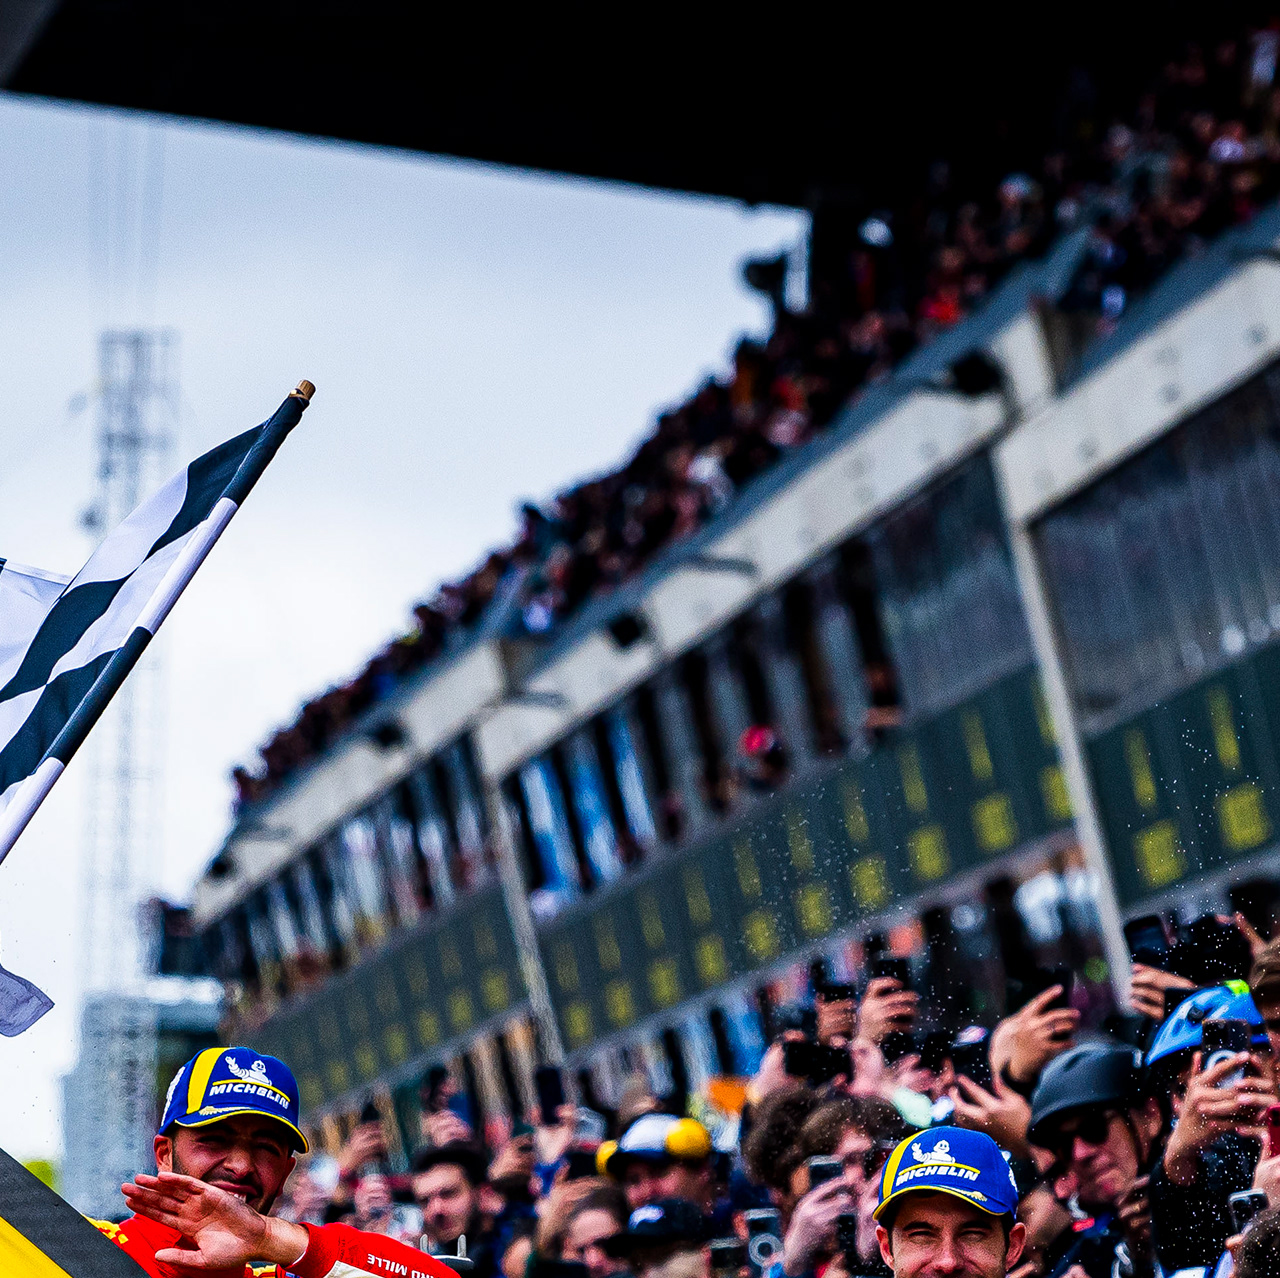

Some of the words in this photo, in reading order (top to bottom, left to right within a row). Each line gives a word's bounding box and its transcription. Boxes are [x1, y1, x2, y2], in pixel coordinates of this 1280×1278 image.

[209, 1083, 290, 1110] MICHELIN
[896, 1166, 979, 1187] MICHELIN
[367, 1253, 408, 1276] MILLE
